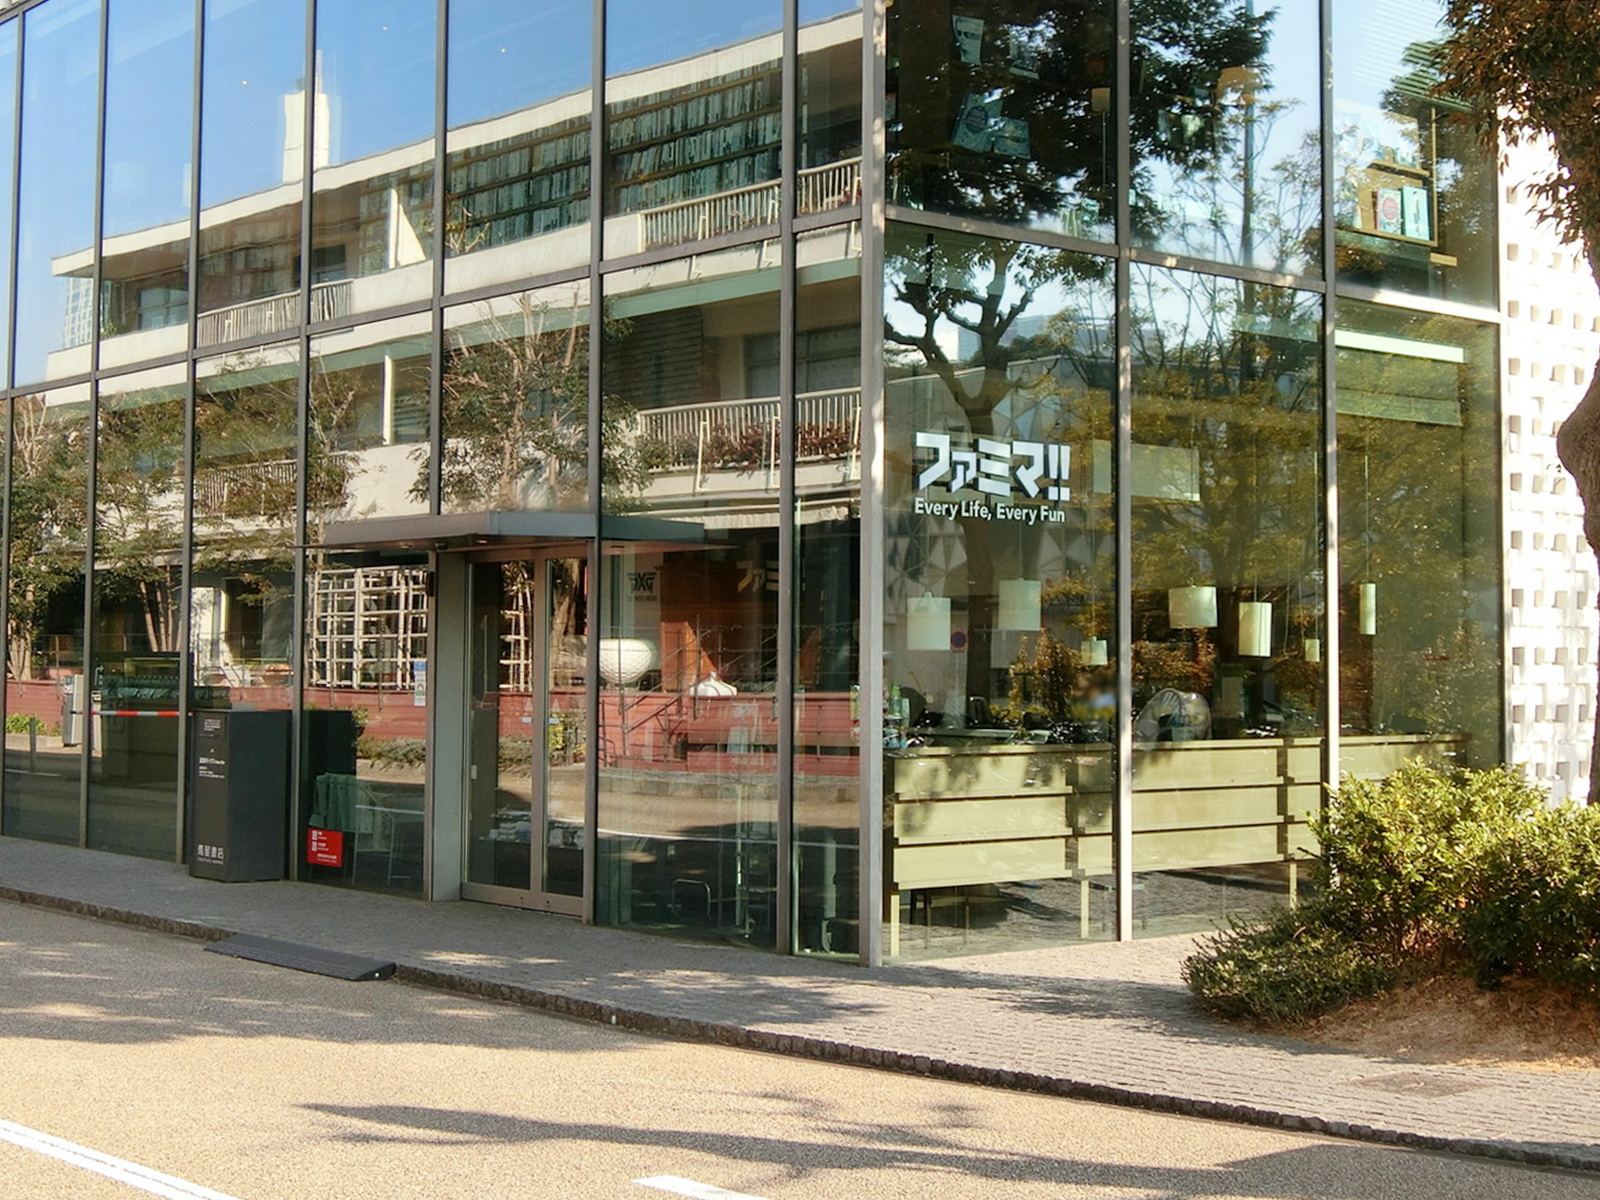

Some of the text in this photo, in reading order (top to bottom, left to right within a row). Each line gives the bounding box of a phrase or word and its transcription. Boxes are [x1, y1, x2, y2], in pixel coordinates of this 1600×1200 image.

[916, 432, 1071, 501] ファミマ!!
[915, 497, 1065, 525] Every Life, Every Fun
